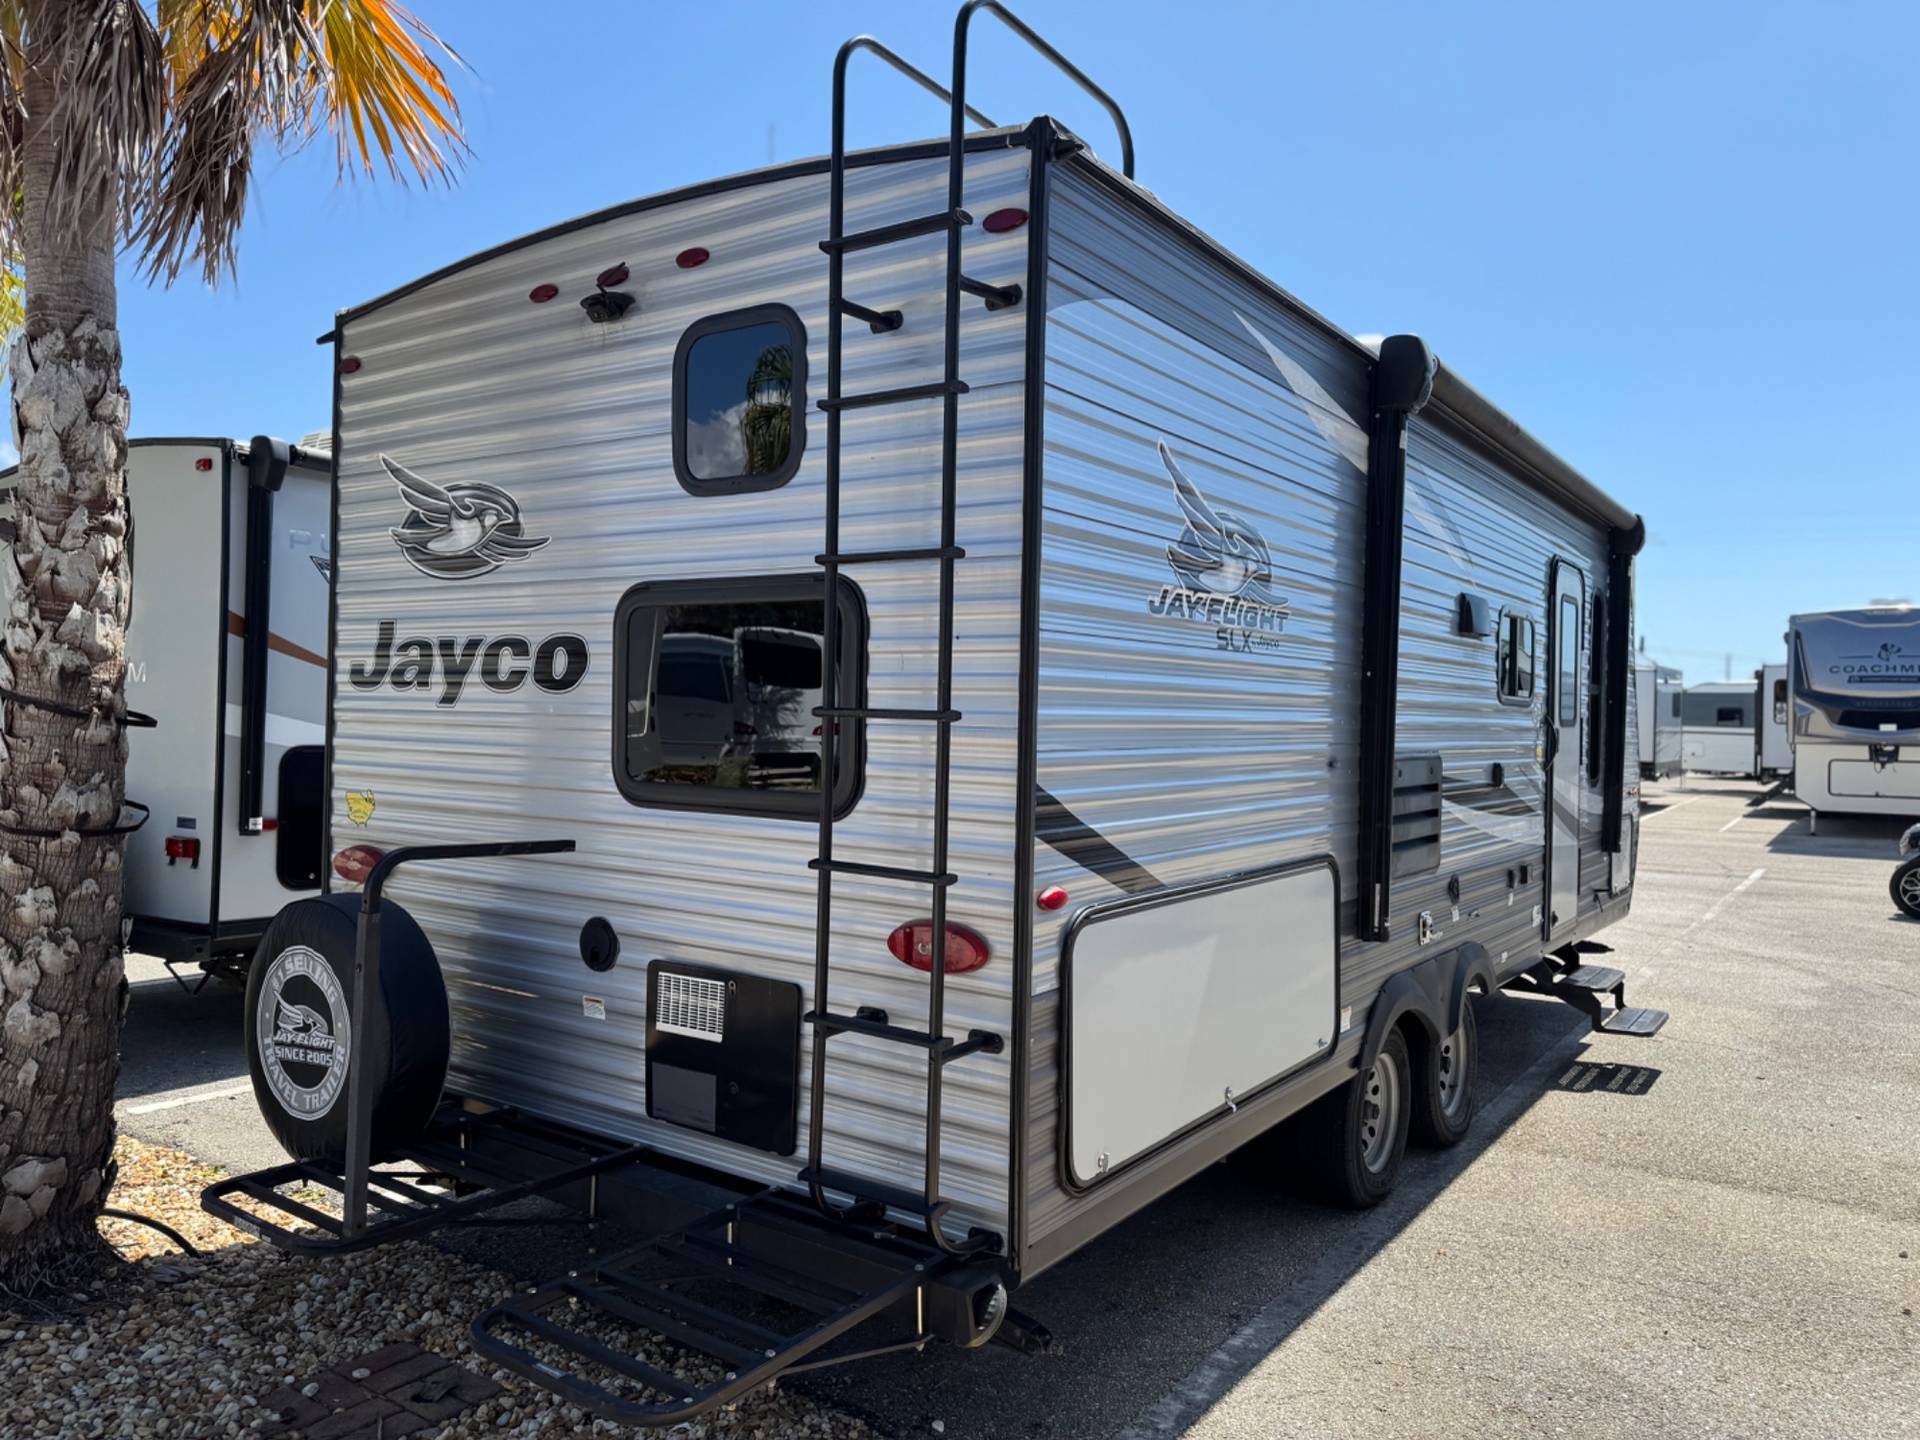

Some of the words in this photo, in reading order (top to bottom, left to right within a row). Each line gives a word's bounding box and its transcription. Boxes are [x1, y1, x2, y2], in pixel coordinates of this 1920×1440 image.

[1215, 627, 1253, 652] SLX
[349, 618, 590, 708] Jayco
[1828, 664, 1920, 674] COACHM
[284, 955, 340, 1003] SELLING
[263, 1036, 298, 1108] TRAVEL
[303, 1045, 346, 1111] TRAILER
[274, 1046, 305, 1061] SINCE
[306, 1050, 333, 1067] 2005
